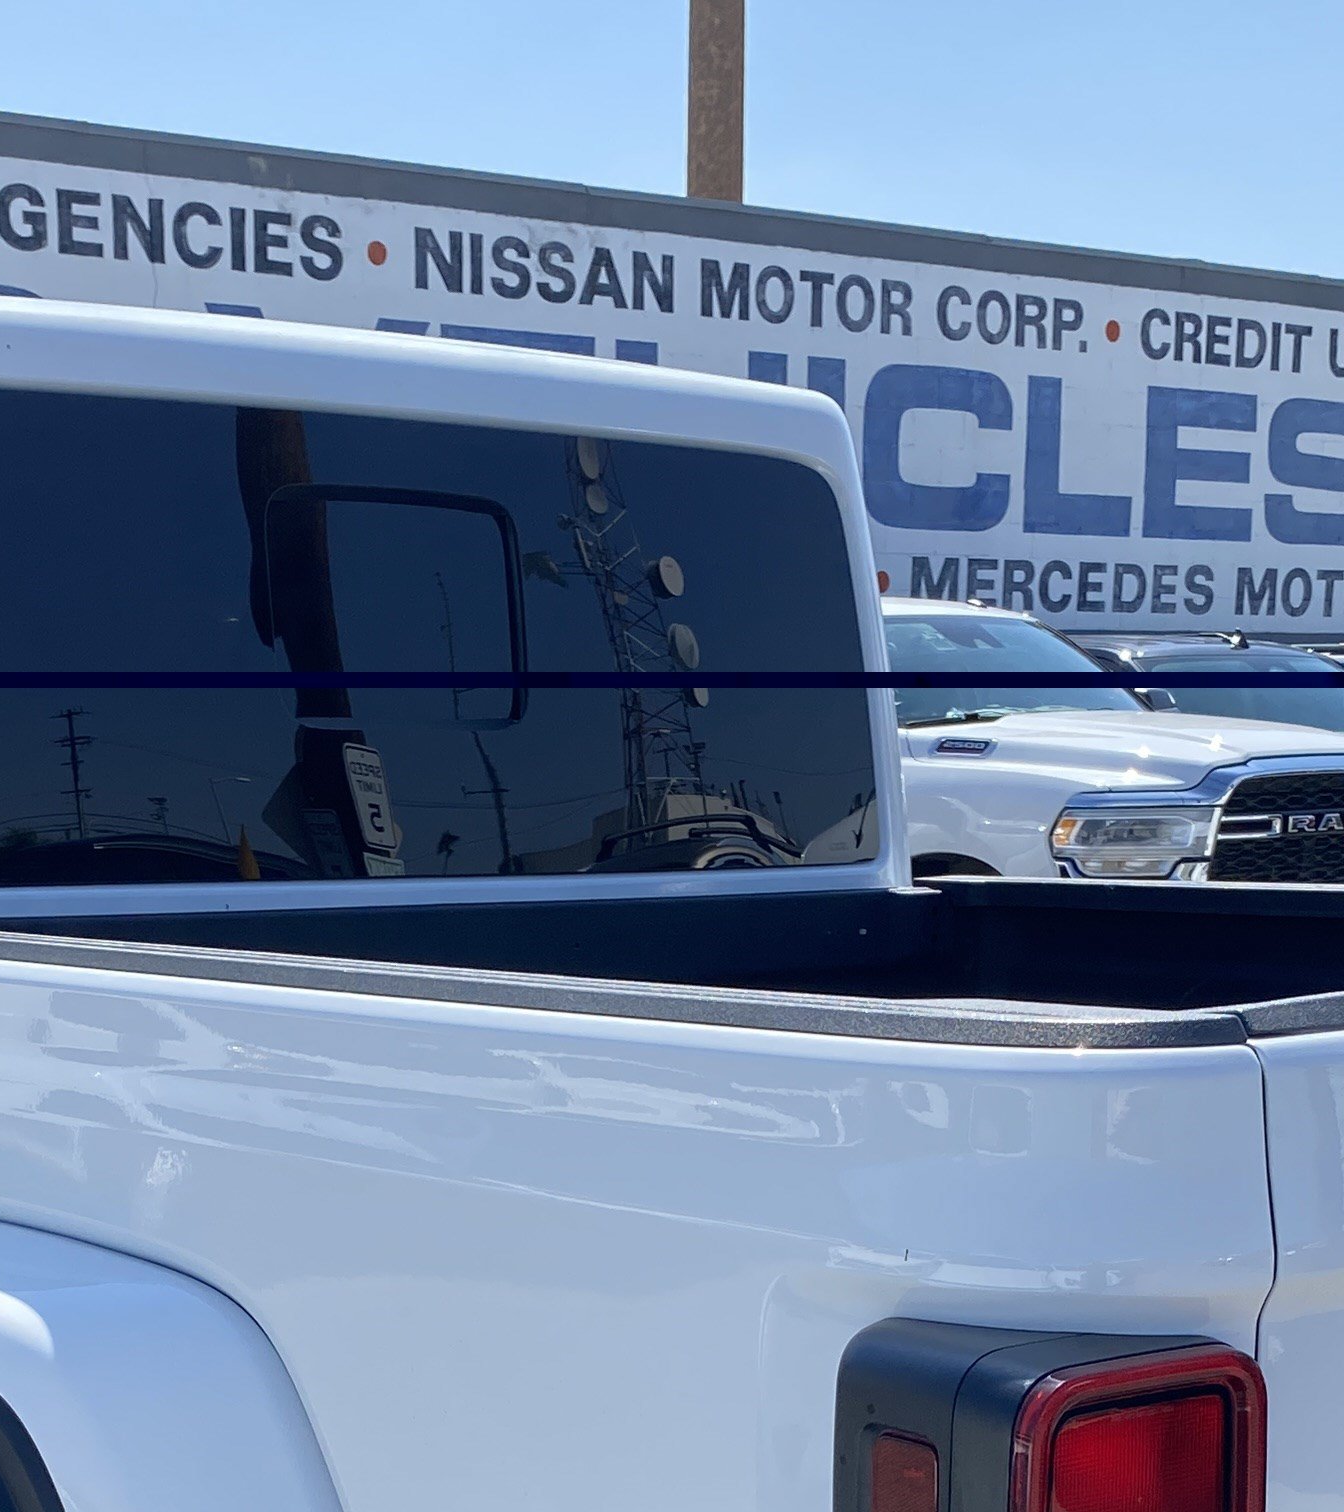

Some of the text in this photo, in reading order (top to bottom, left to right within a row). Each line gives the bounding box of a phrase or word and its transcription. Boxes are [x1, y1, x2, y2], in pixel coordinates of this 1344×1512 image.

[413, 226, 1088, 353] NISSAN MOTOR CORP.
[1140, 307, 1312, 373] CREDIT
[911, 556, 1214, 616] MERCEDES
